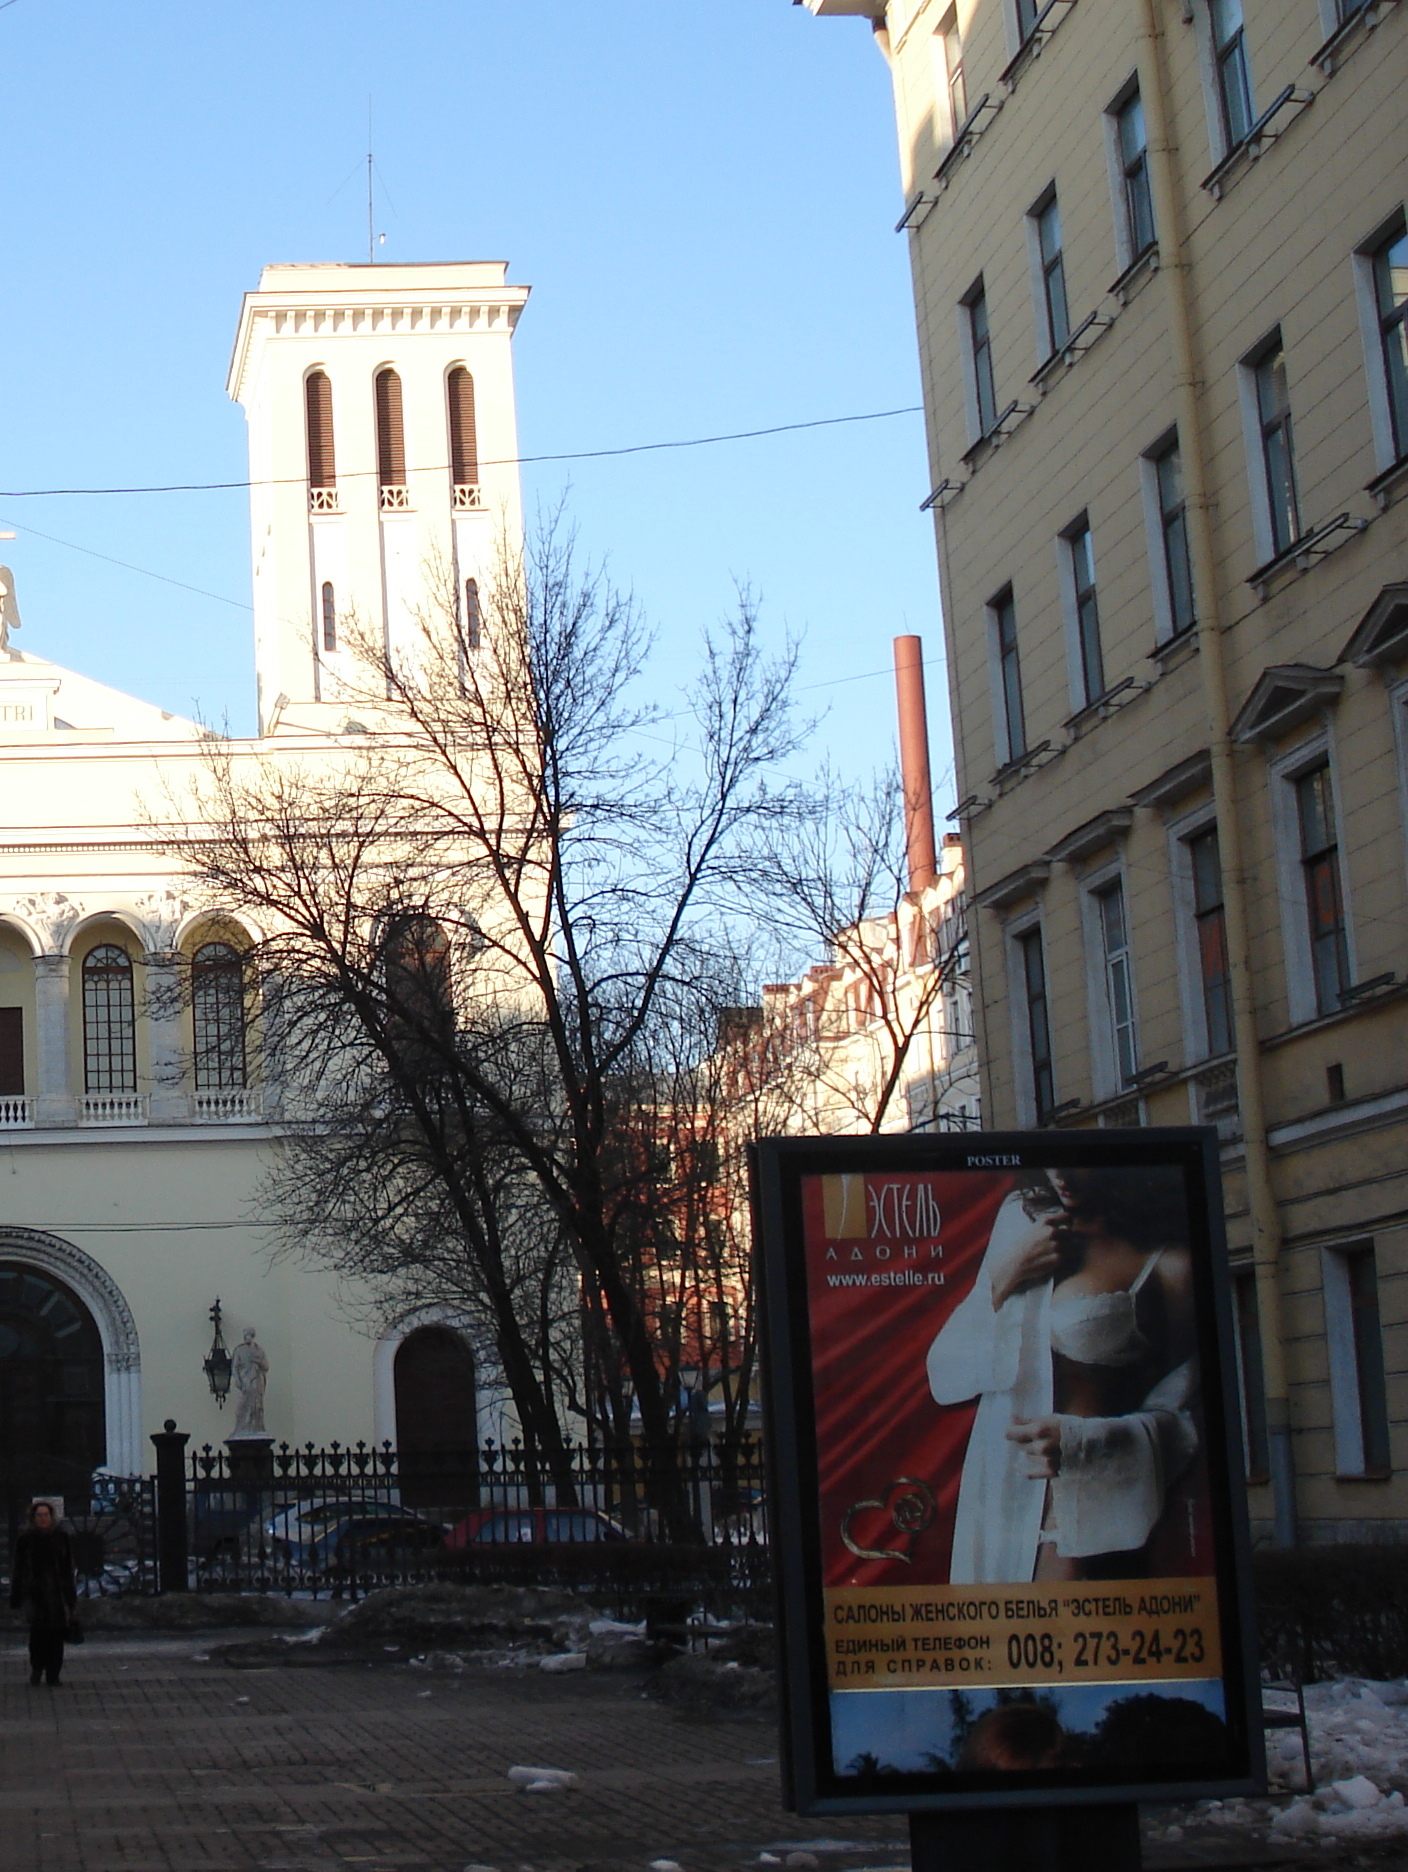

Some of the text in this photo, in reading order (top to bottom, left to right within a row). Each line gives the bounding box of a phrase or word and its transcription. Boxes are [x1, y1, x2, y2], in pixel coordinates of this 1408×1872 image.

[967, 1155, 1021, 1166] POSTER
[867, 1183, 941, 1239] ЭСТЕЛЬ
[826, 1246, 943, 1261] АДОНИ
[827, 1270, 945, 1287] www.estelle.ru
[834, 1603, 905, 1624] САЛОНЫ
[909, 1601, 1000, 1622] ЖЕНСКОГО
[1005, 1599, 1058, 1619] БЕЛЬЯ
[835, 1635, 990, 1655] ЕДИНЫЙ ТЕЛЕФОН
[1007, 1626, 1205, 1673] 008; 273-24-23
[835, 1656, 992, 1677] ДЛЯ СПРАВОК:
